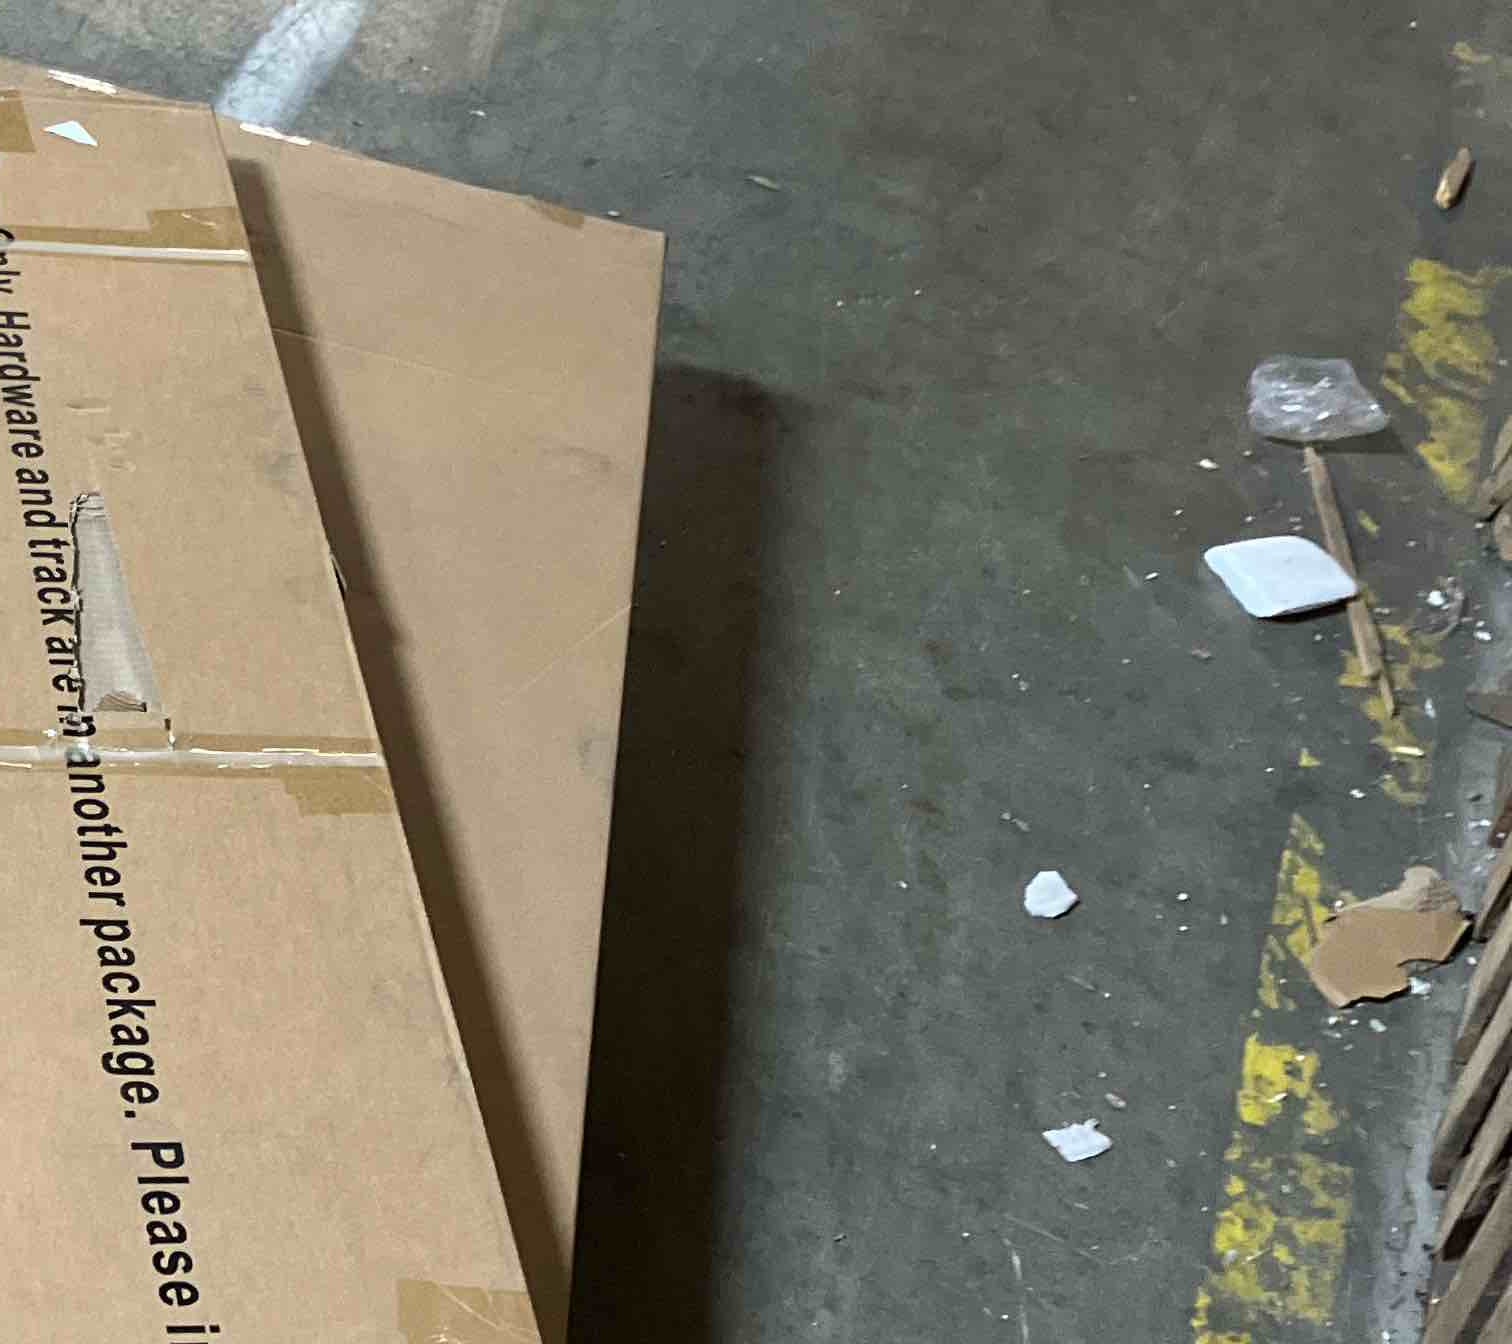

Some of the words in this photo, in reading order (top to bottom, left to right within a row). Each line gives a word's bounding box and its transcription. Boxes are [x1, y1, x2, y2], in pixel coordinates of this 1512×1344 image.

[16, 468, 70, 529] and
[28, 538, 75, 626] track
[65, 750, 129, 906] another
[79, 919, 159, 1118] package.
[131, 1142, 199, 1306] Please
